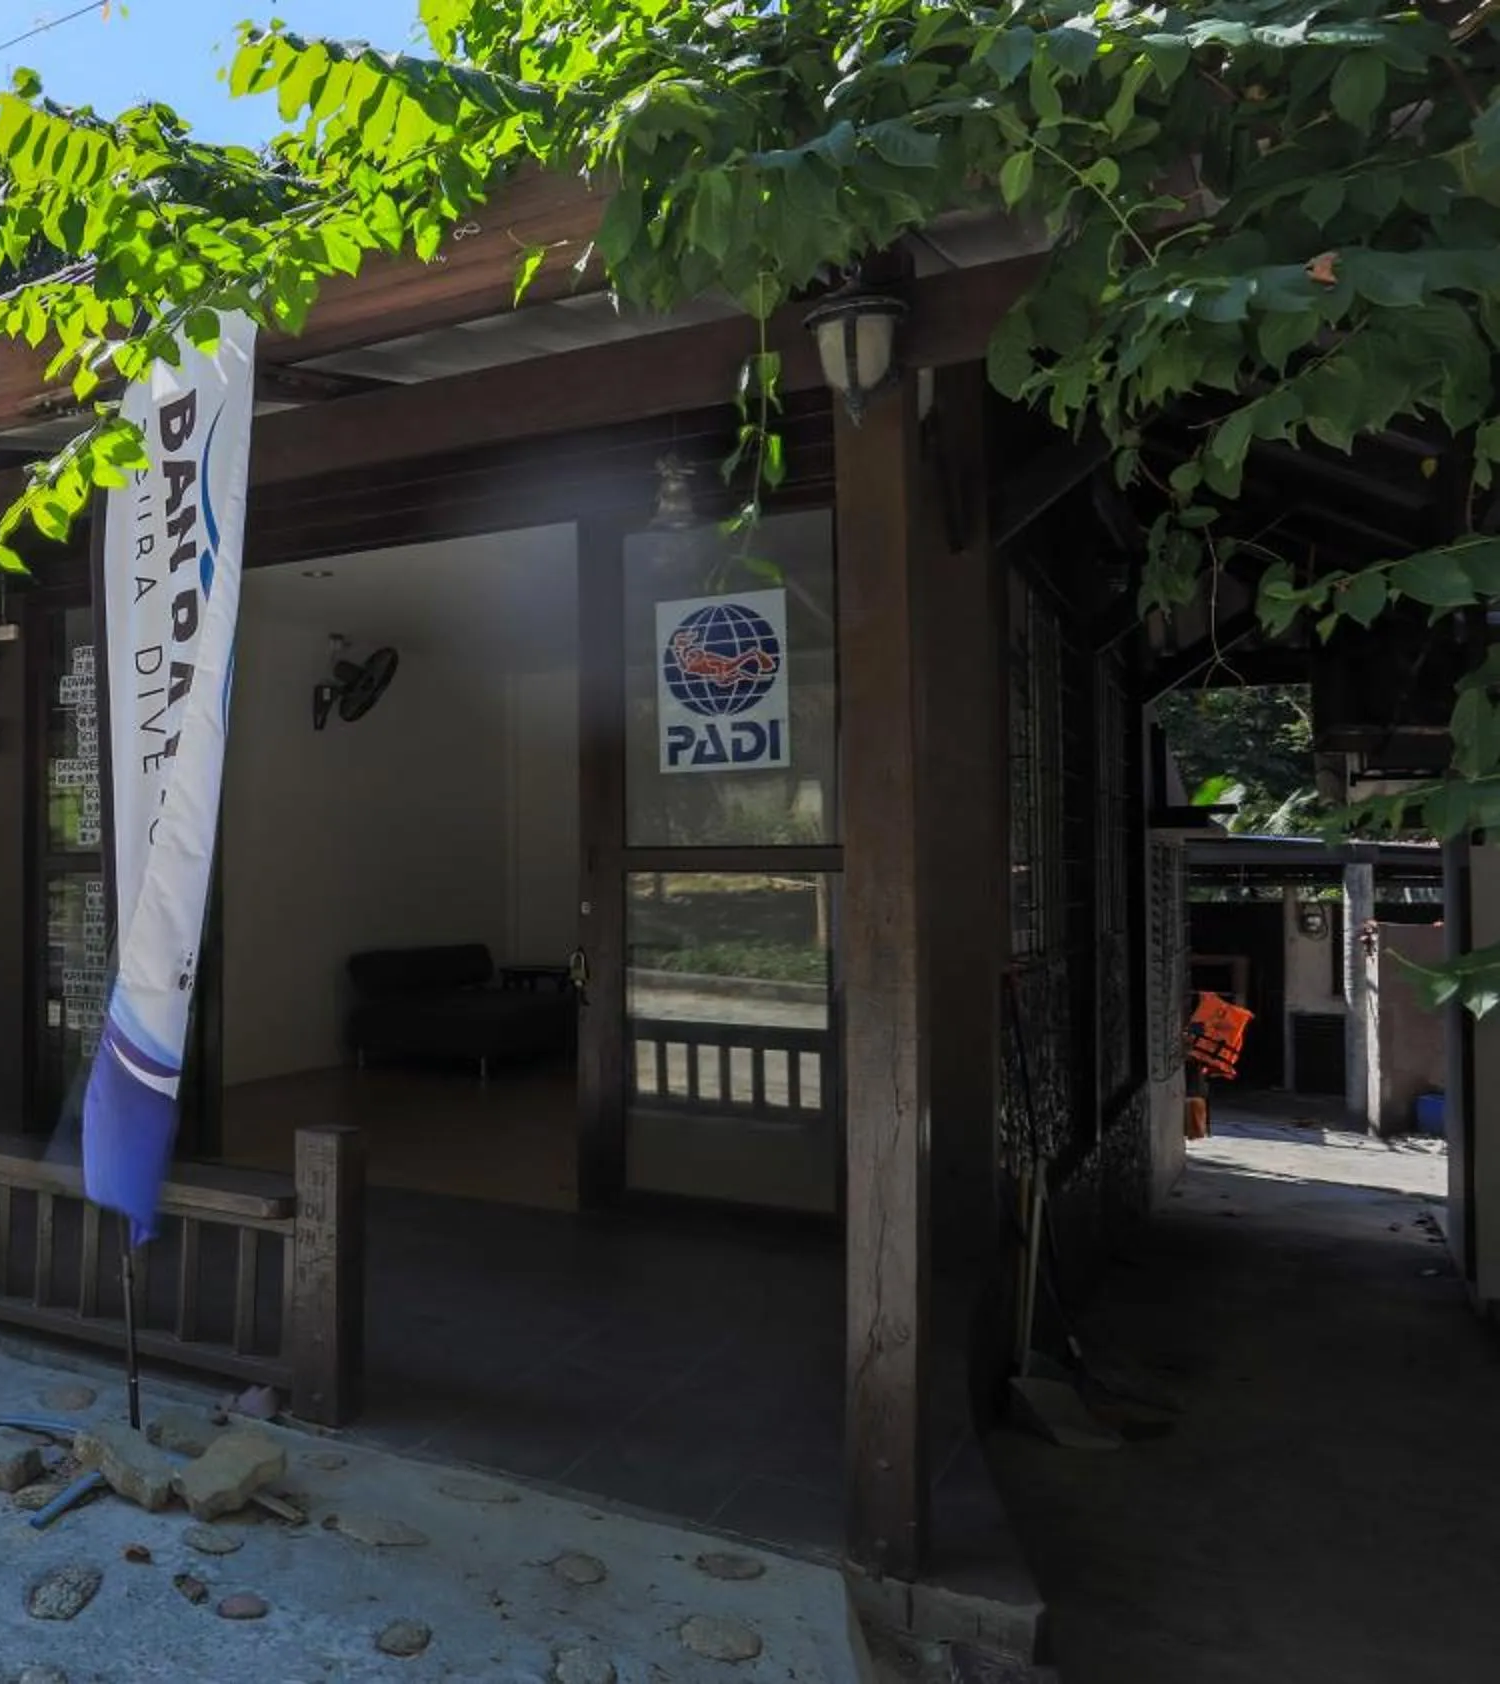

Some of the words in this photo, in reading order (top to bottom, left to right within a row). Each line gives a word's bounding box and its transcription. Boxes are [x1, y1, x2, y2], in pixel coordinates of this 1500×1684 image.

[159, 388, 197, 573] BAN
[135, 645, 168, 774] DIVE
[667, 719, 781, 766] PADI
